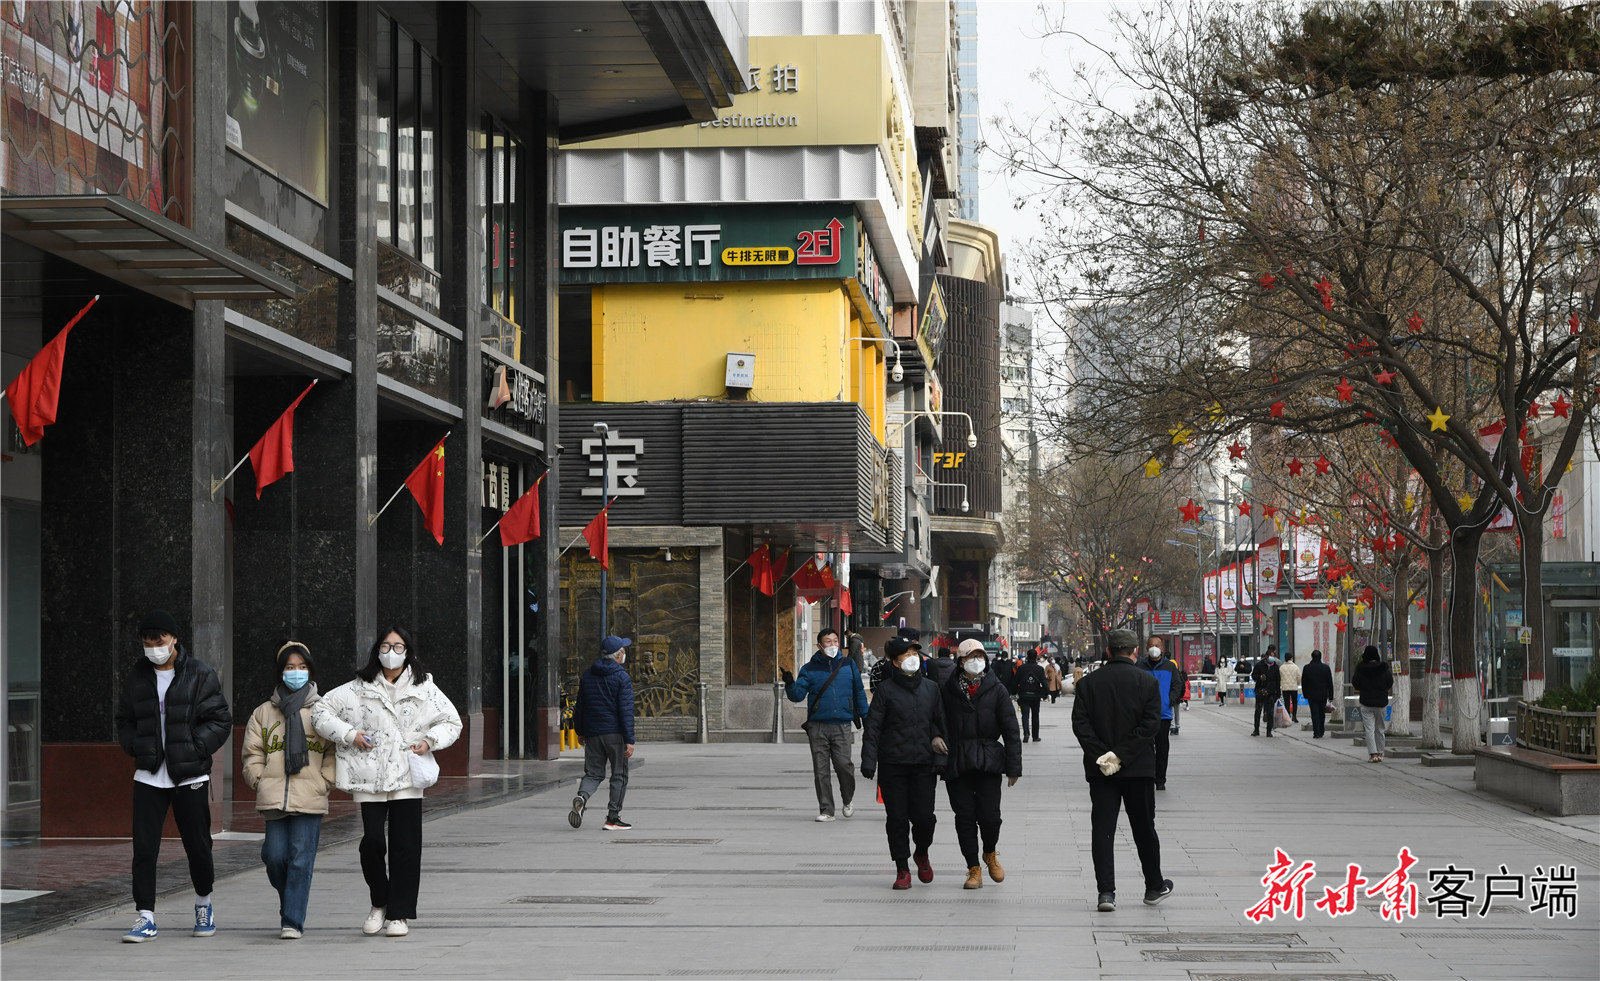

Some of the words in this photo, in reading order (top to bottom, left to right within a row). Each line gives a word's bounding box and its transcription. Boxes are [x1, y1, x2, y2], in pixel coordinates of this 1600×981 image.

[563, 224, 721, 268] 自助餐厅
[726, 249, 789, 262] 牛排无限量
[797, 230, 829, 256] 2F
[581, 430, 645, 498] 宝
